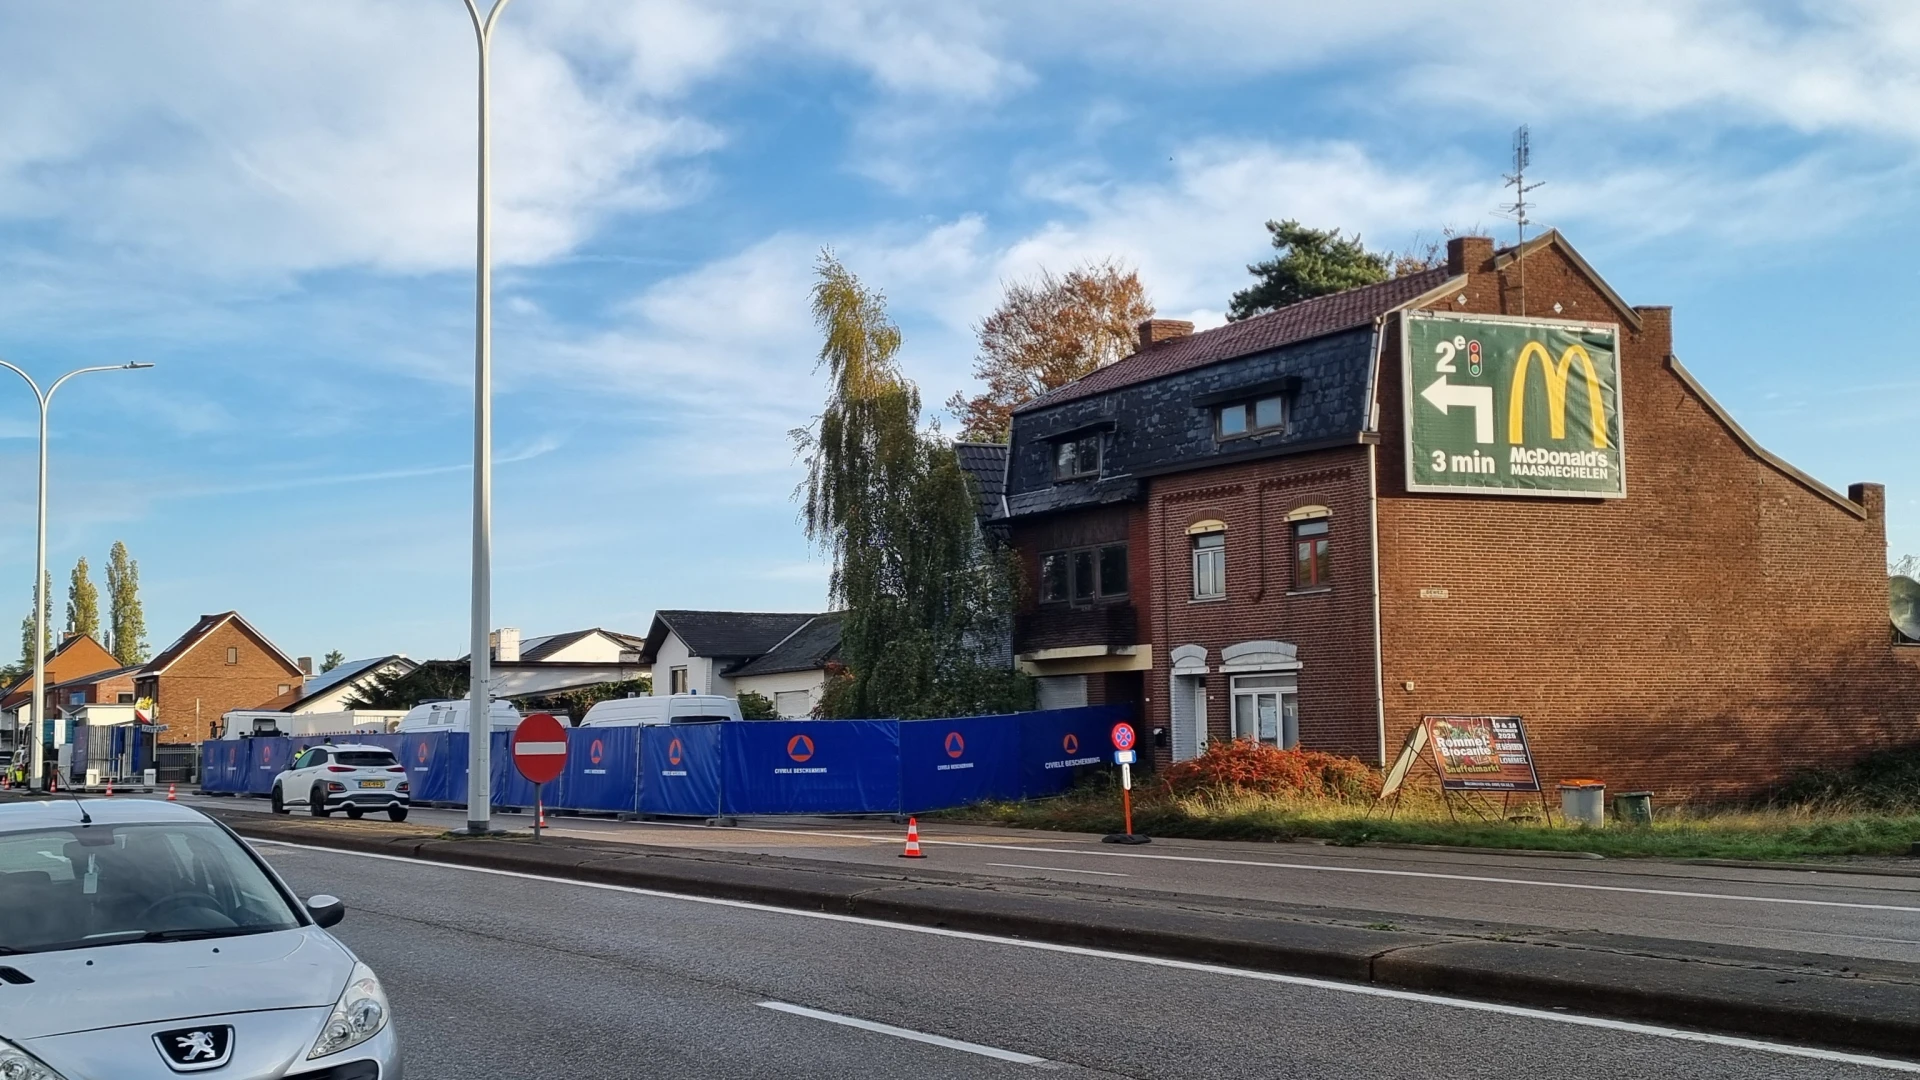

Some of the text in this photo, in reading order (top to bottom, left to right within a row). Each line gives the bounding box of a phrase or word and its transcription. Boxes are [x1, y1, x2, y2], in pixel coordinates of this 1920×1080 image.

[1432, 449, 1495, 474] 3 min
[1510, 446, 1608, 468] McDonald's
[1510, 464, 1608, 479] MAASMECHELEN
[1442, 747, 1491, 756] Brocante
[1446, 765, 1500, 773] Snuffelmarkt
